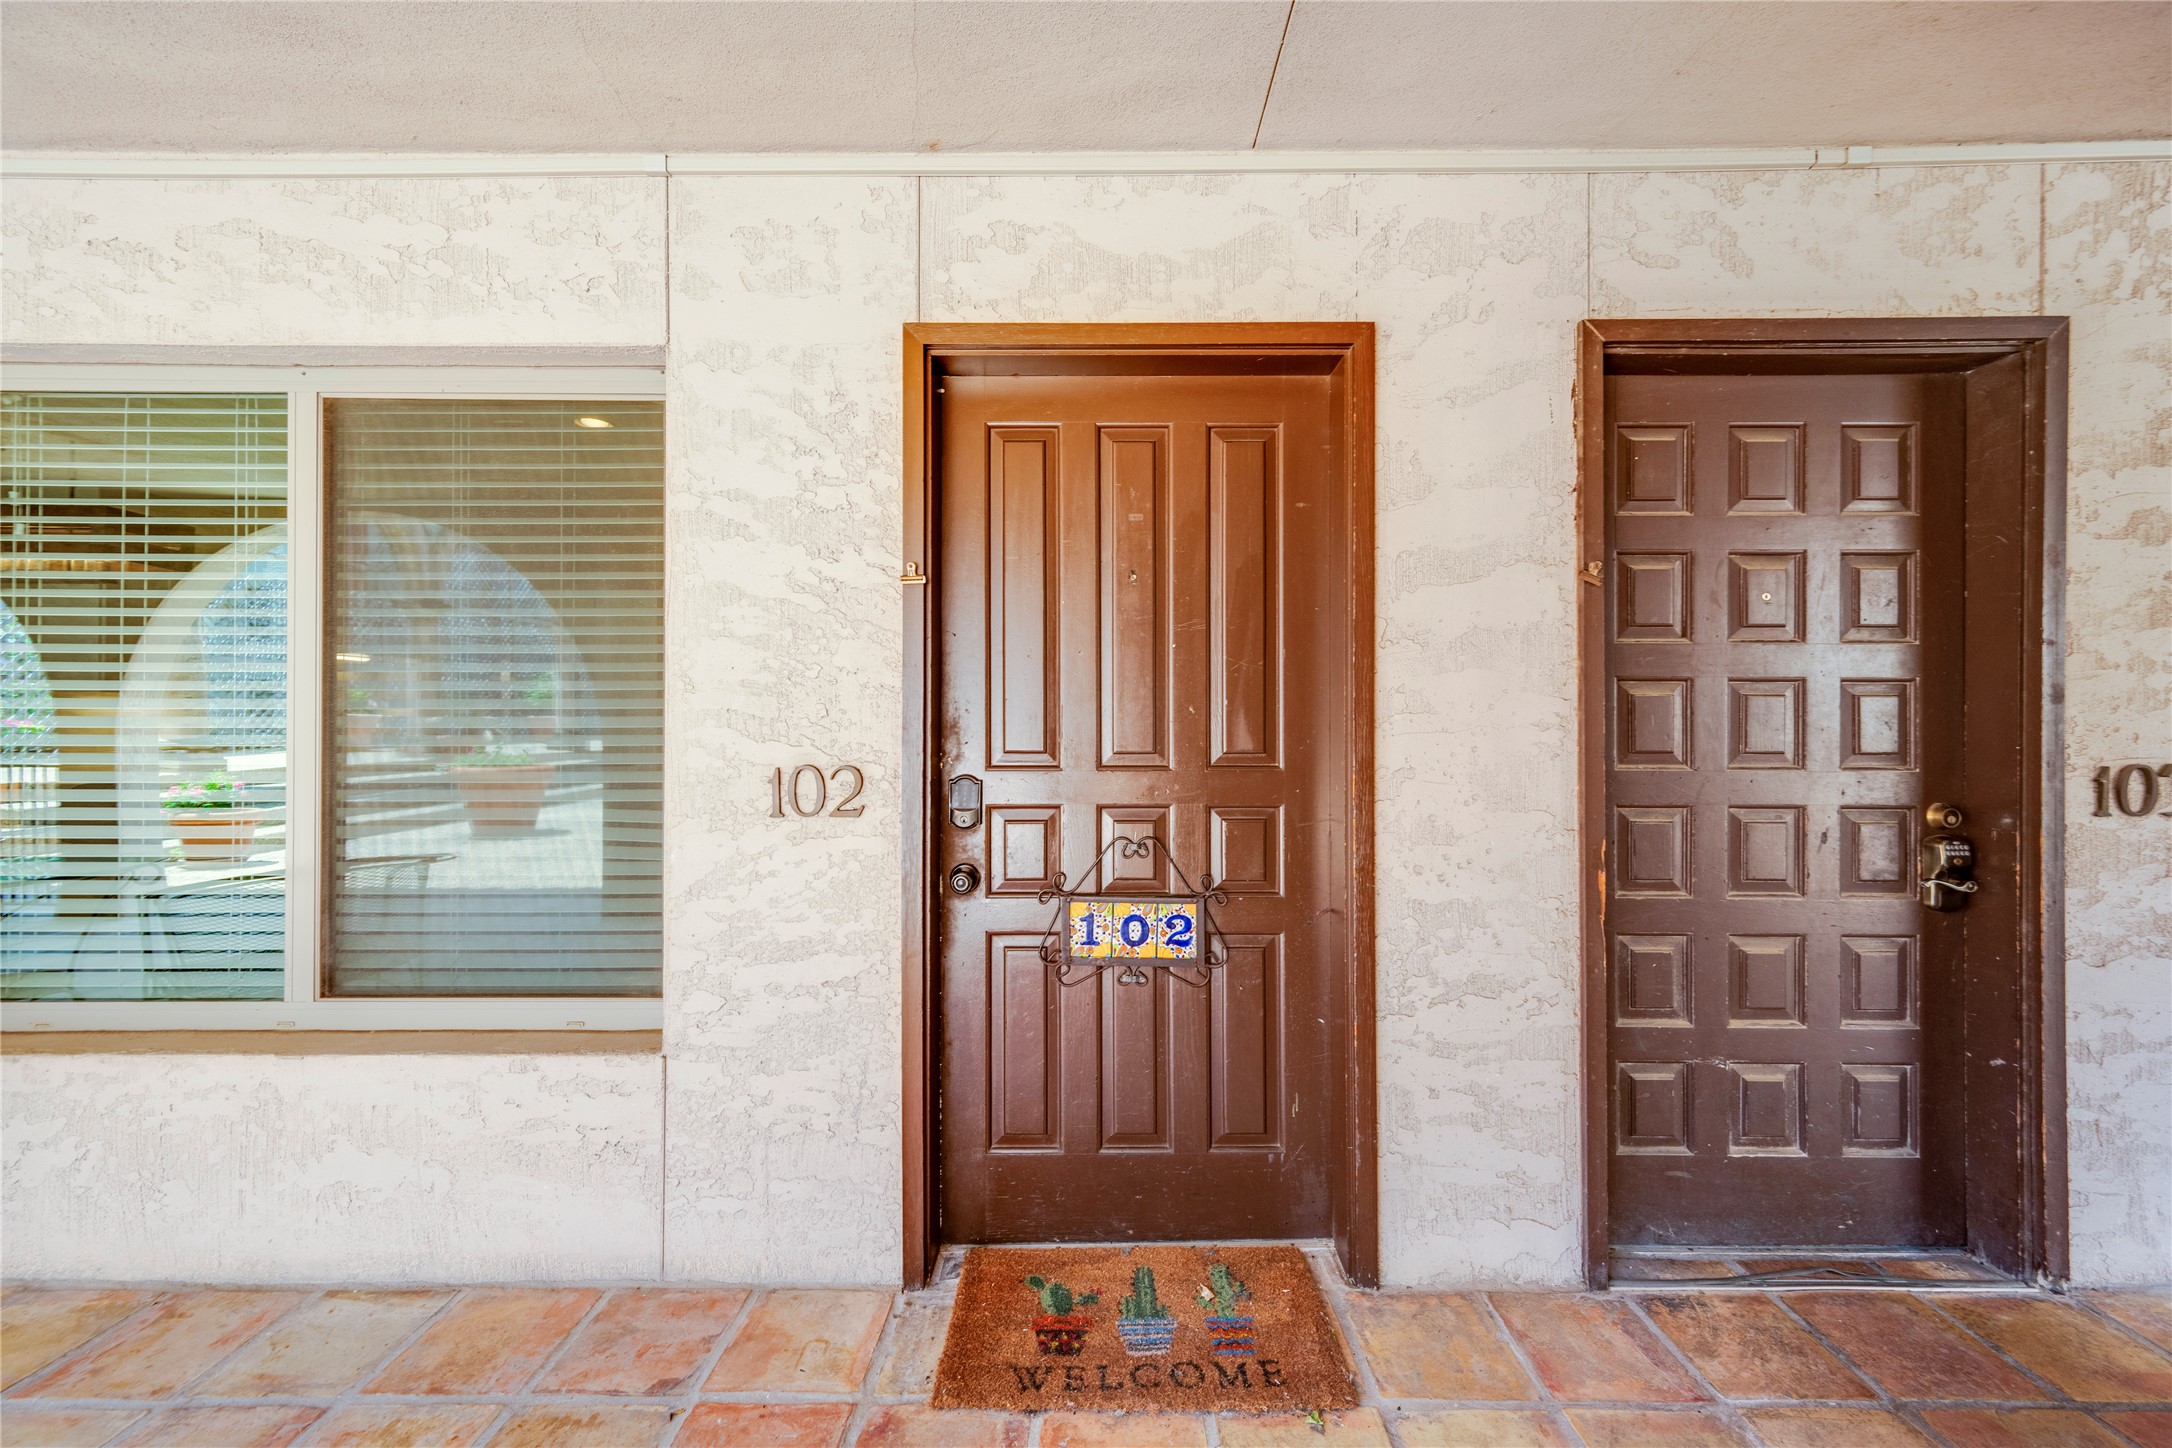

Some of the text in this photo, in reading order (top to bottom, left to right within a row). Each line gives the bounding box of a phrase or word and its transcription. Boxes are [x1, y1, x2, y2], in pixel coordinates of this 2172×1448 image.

[767, 764, 865, 818] 102
[1079, 912, 1194, 948] 102
[1009, 1359, 1287, 1394] WELCOME
